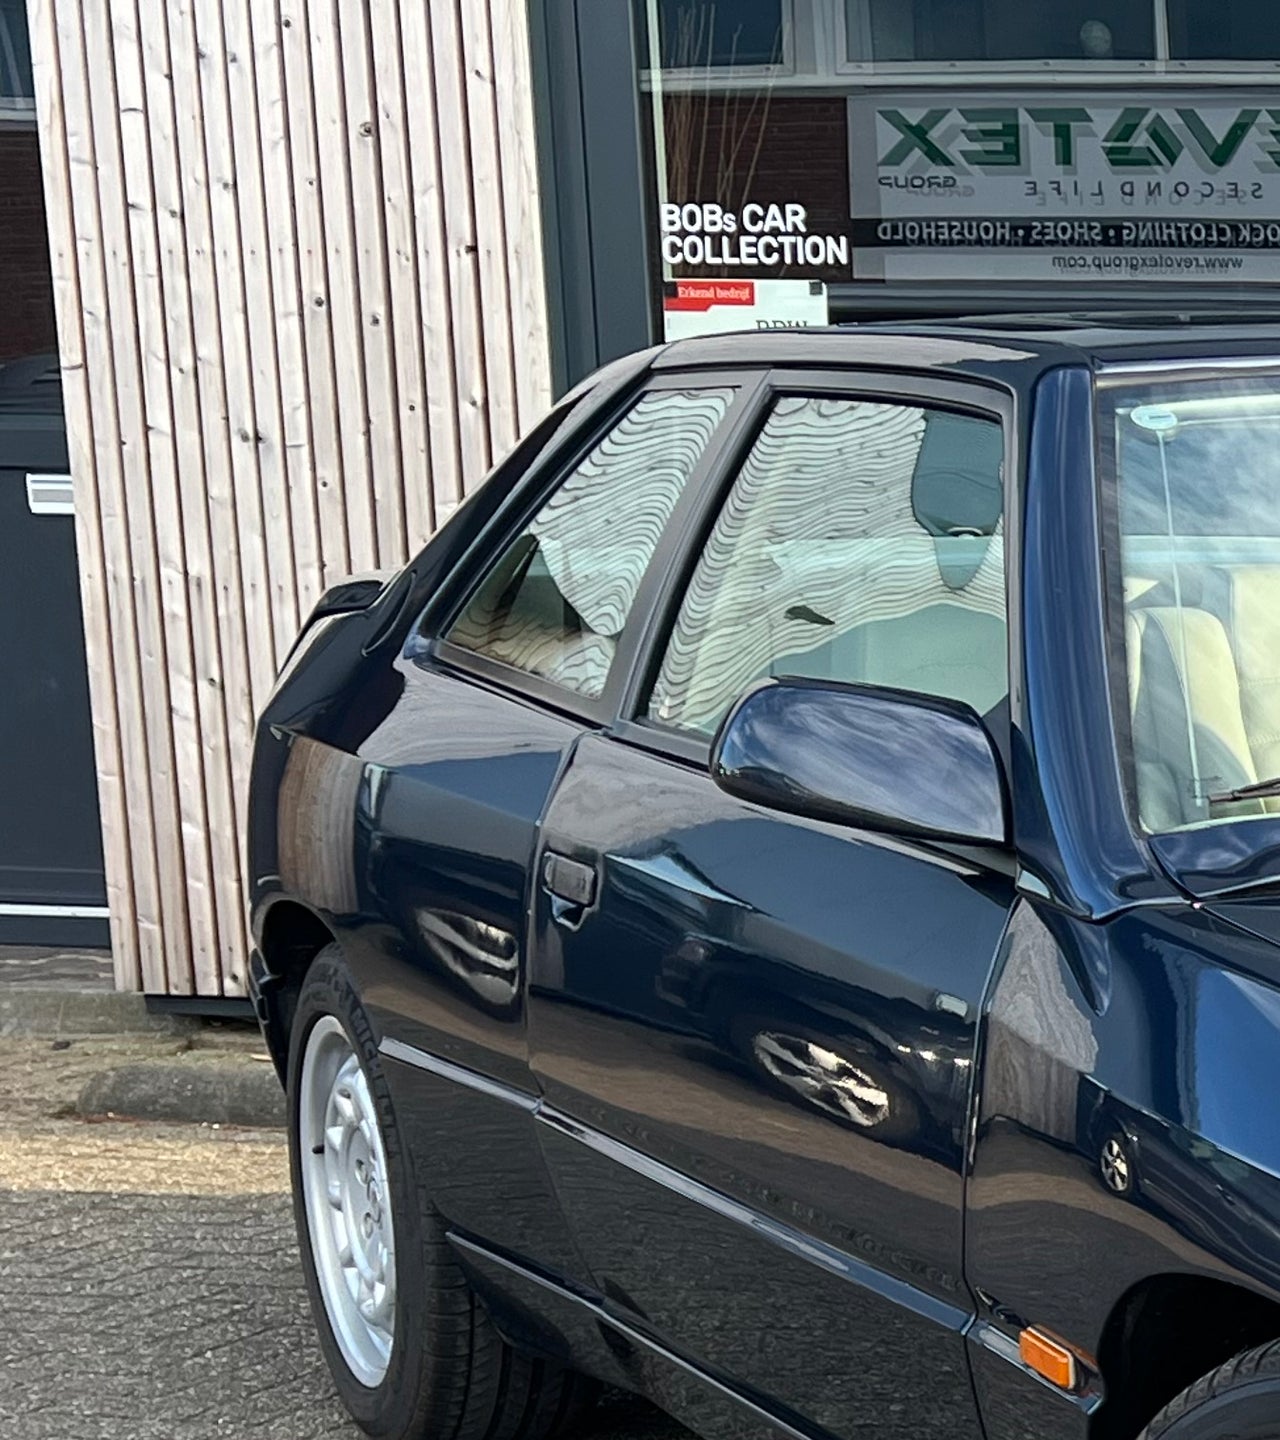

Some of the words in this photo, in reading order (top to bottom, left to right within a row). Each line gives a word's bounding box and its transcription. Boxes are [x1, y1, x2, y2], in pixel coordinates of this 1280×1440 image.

[660, 203, 737, 232] BOBs
[742, 203, 807, 232] CAR
[661, 235, 848, 265] COLLECTION
